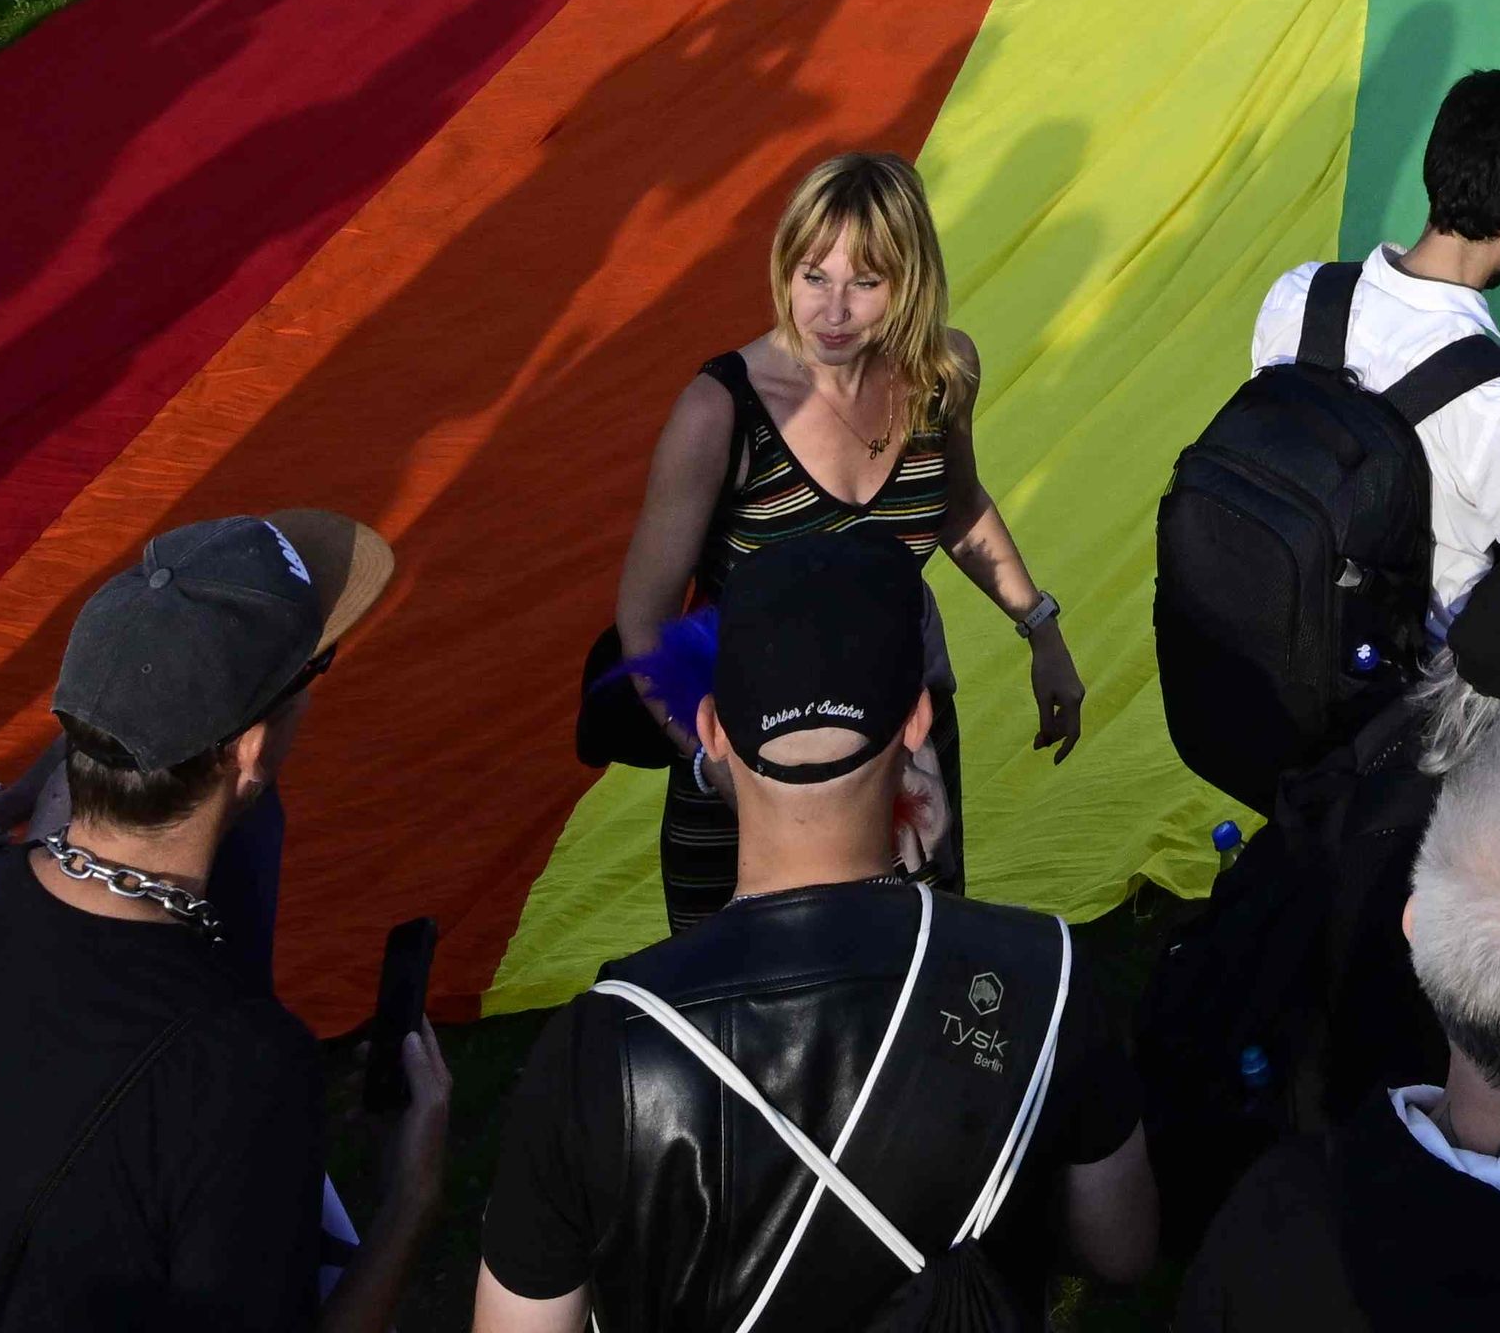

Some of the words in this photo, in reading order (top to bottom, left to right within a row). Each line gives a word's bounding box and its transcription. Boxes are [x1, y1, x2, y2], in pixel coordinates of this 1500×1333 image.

[761, 706, 802, 731] Barber
[816, 699, 865, 720] Butcher
[940, 1010, 1009, 1058] Tysk
[973, 1052, 1005, 1073] Berlin
